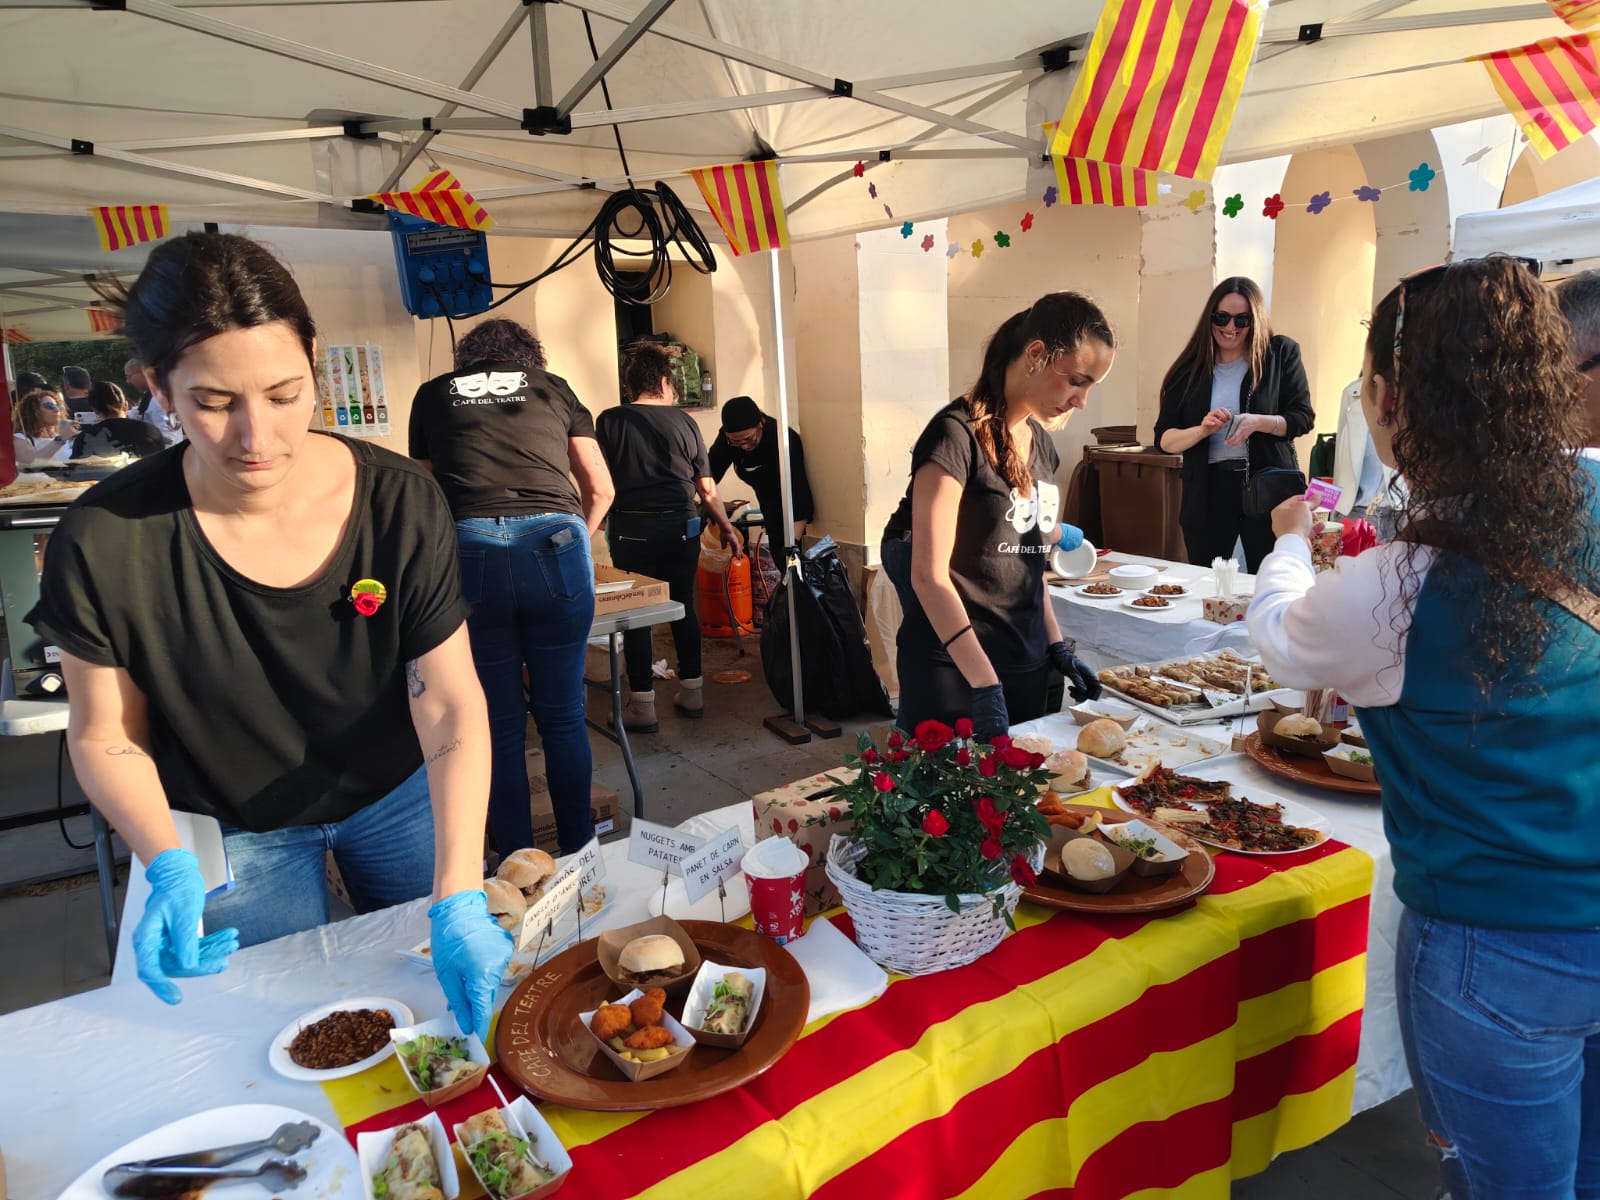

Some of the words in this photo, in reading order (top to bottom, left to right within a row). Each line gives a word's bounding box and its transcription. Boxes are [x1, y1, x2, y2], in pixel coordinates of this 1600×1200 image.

[495, 395, 526, 403] TEATRE
[1020, 545, 1037, 554] DEL
[640, 831, 675, 848] NUGGETS
[680, 842, 696, 853] AMB
[579, 849, 596, 868] DEL
[685, 856, 707, 876] PANET
[710, 849, 719, 860] DE
[722, 837, 740, 853] CARN
[699, 874, 709, 884] EN
[711, 857, 733, 876] SALSA
[514, 971, 563, 1016] TEATRE
[511, 1022, 530, 1046] DEL
